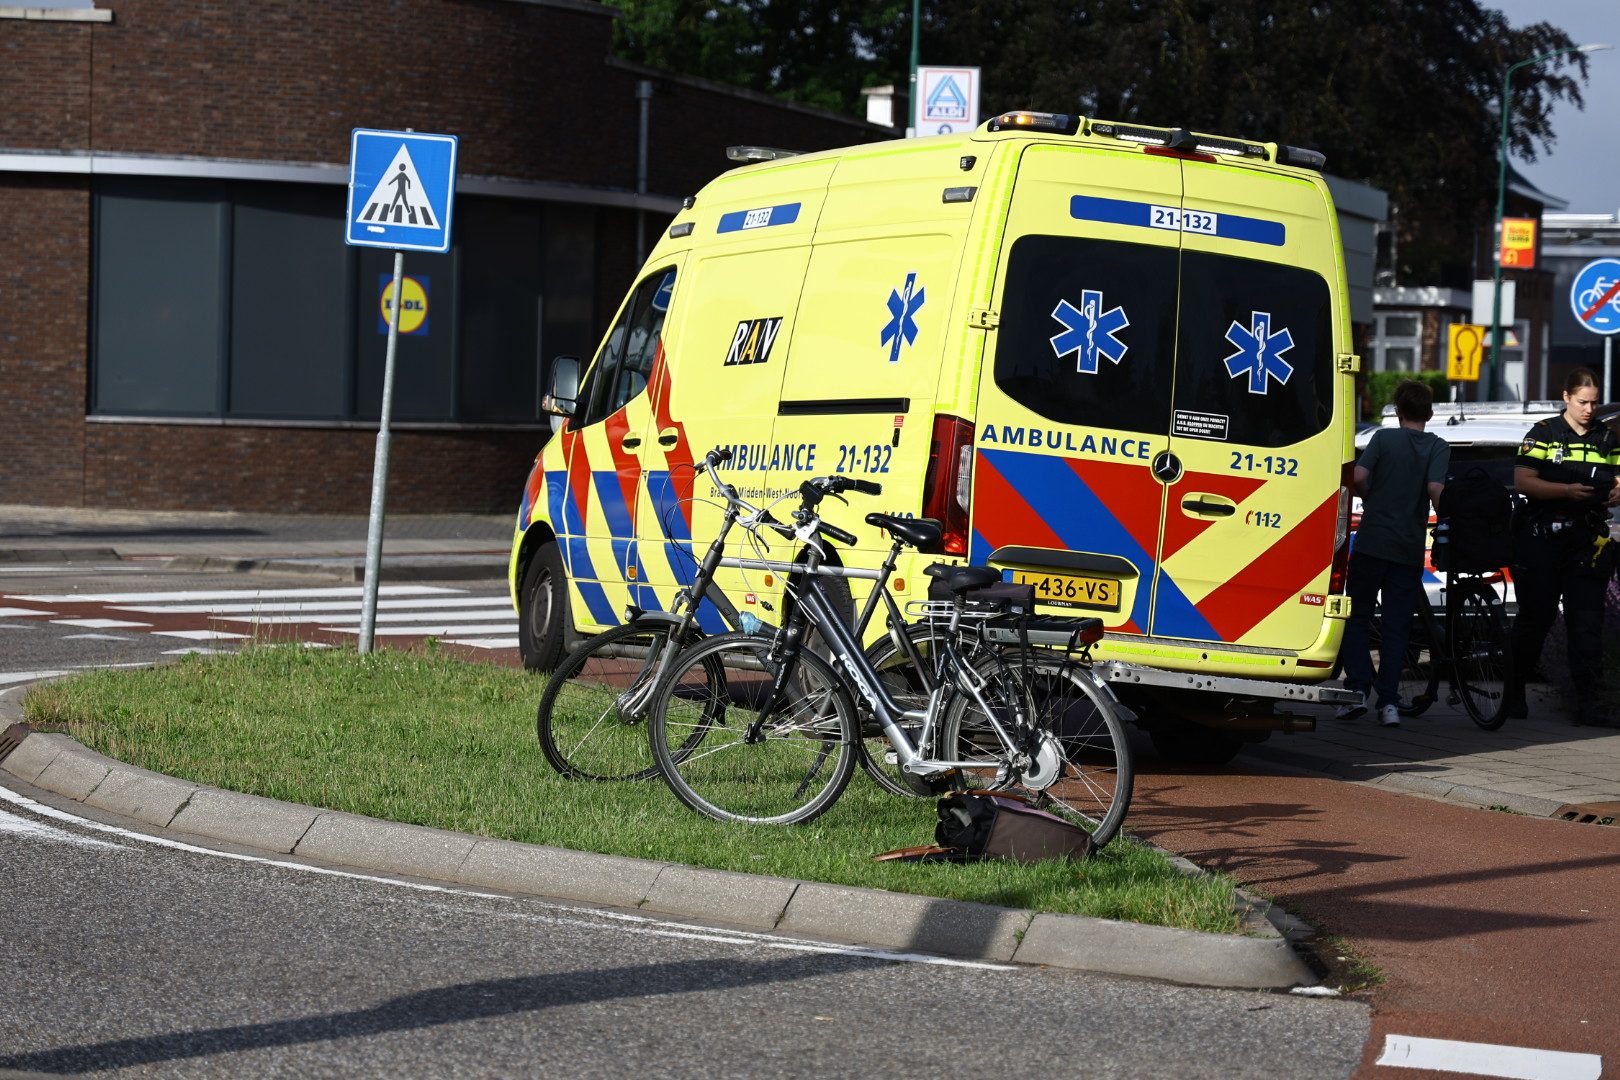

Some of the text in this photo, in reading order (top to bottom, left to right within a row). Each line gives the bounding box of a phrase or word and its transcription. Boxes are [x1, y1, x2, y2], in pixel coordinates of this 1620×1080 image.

[745, 210, 770, 226] 21-132
[1155, 209, 1212, 231] 21-132
[385, 300, 424, 310] LDL
[726, 318, 782, 363] RAV
[980, 424, 1151, 460] AMBULANCE
[836, 444, 892, 473] 21-132
[1230, 451, 1298, 477] 21-132
[1303, 595, 1322, 604] WAS
[839, 653, 877, 712] KOGA
